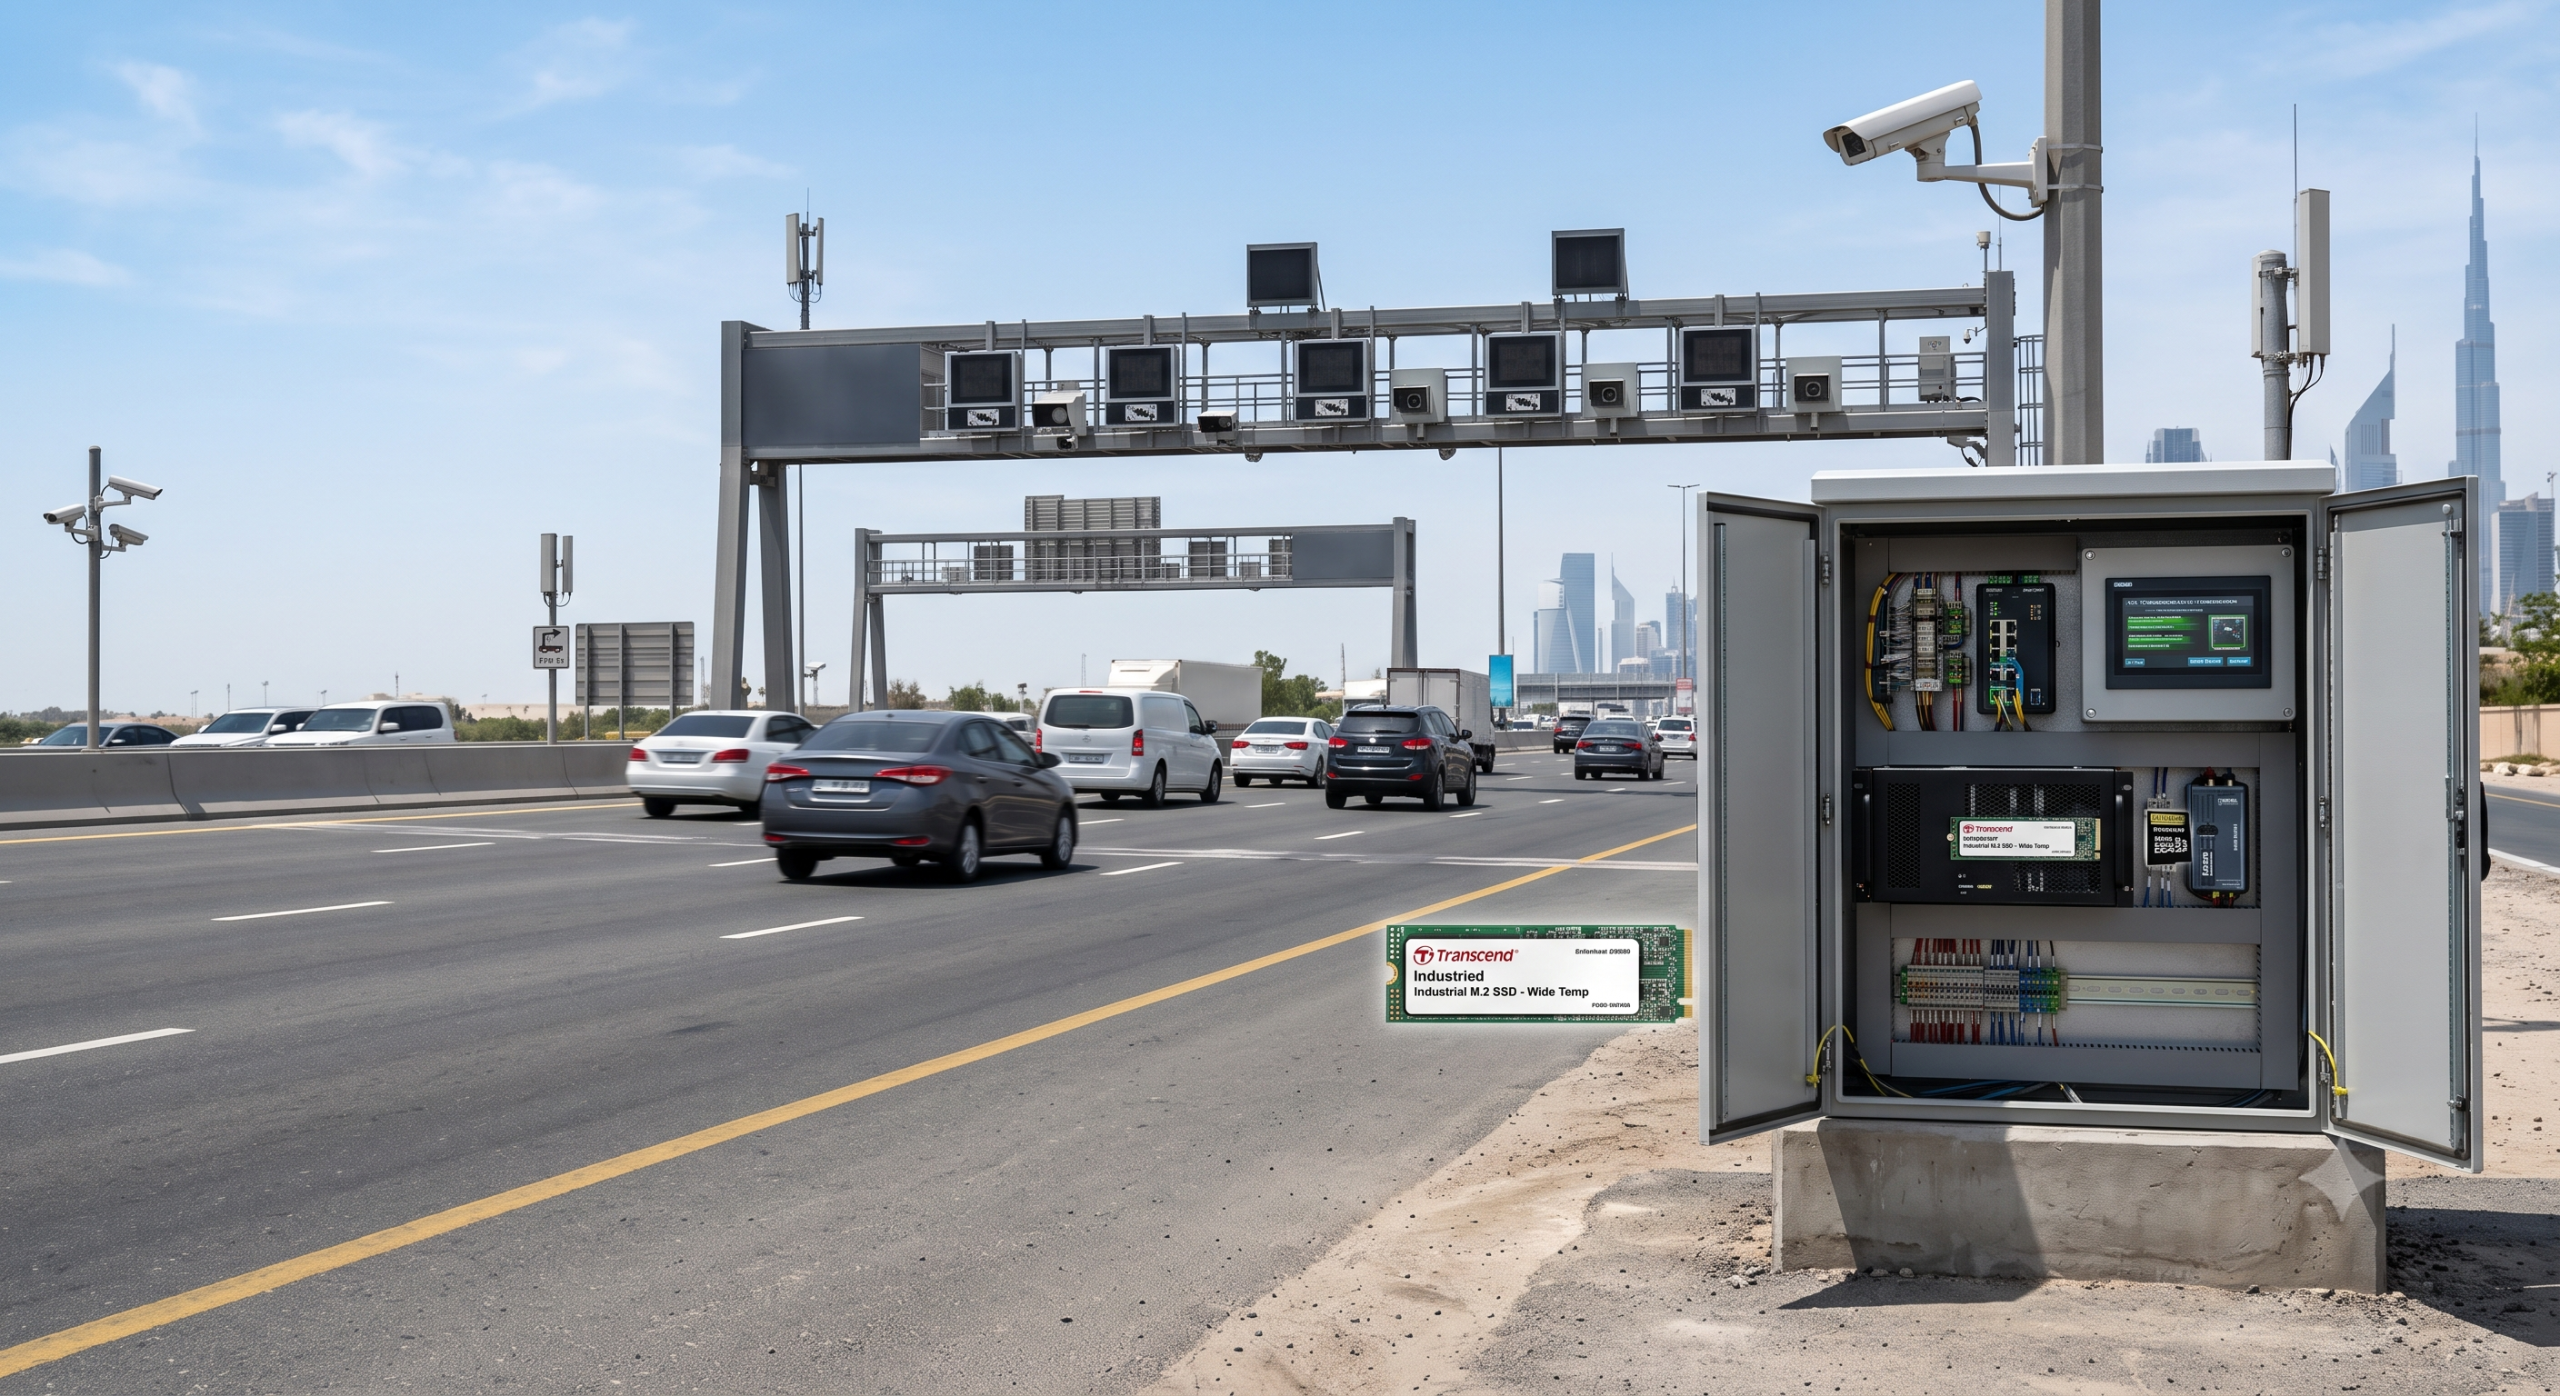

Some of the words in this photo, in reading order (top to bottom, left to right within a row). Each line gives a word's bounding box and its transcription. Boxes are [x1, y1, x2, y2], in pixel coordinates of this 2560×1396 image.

[1437, 949, 1514, 962] Transcend
[1414, 970, 1485, 982] Industried
[1414, 987, 1467, 997] Industrial
[1470, 987, 1490, 997] M.2
[1493, 987, 1517, 997] SSD
[1527, 987, 1556, 997] Wide
[1558, 987, 1589, 999] Temp
